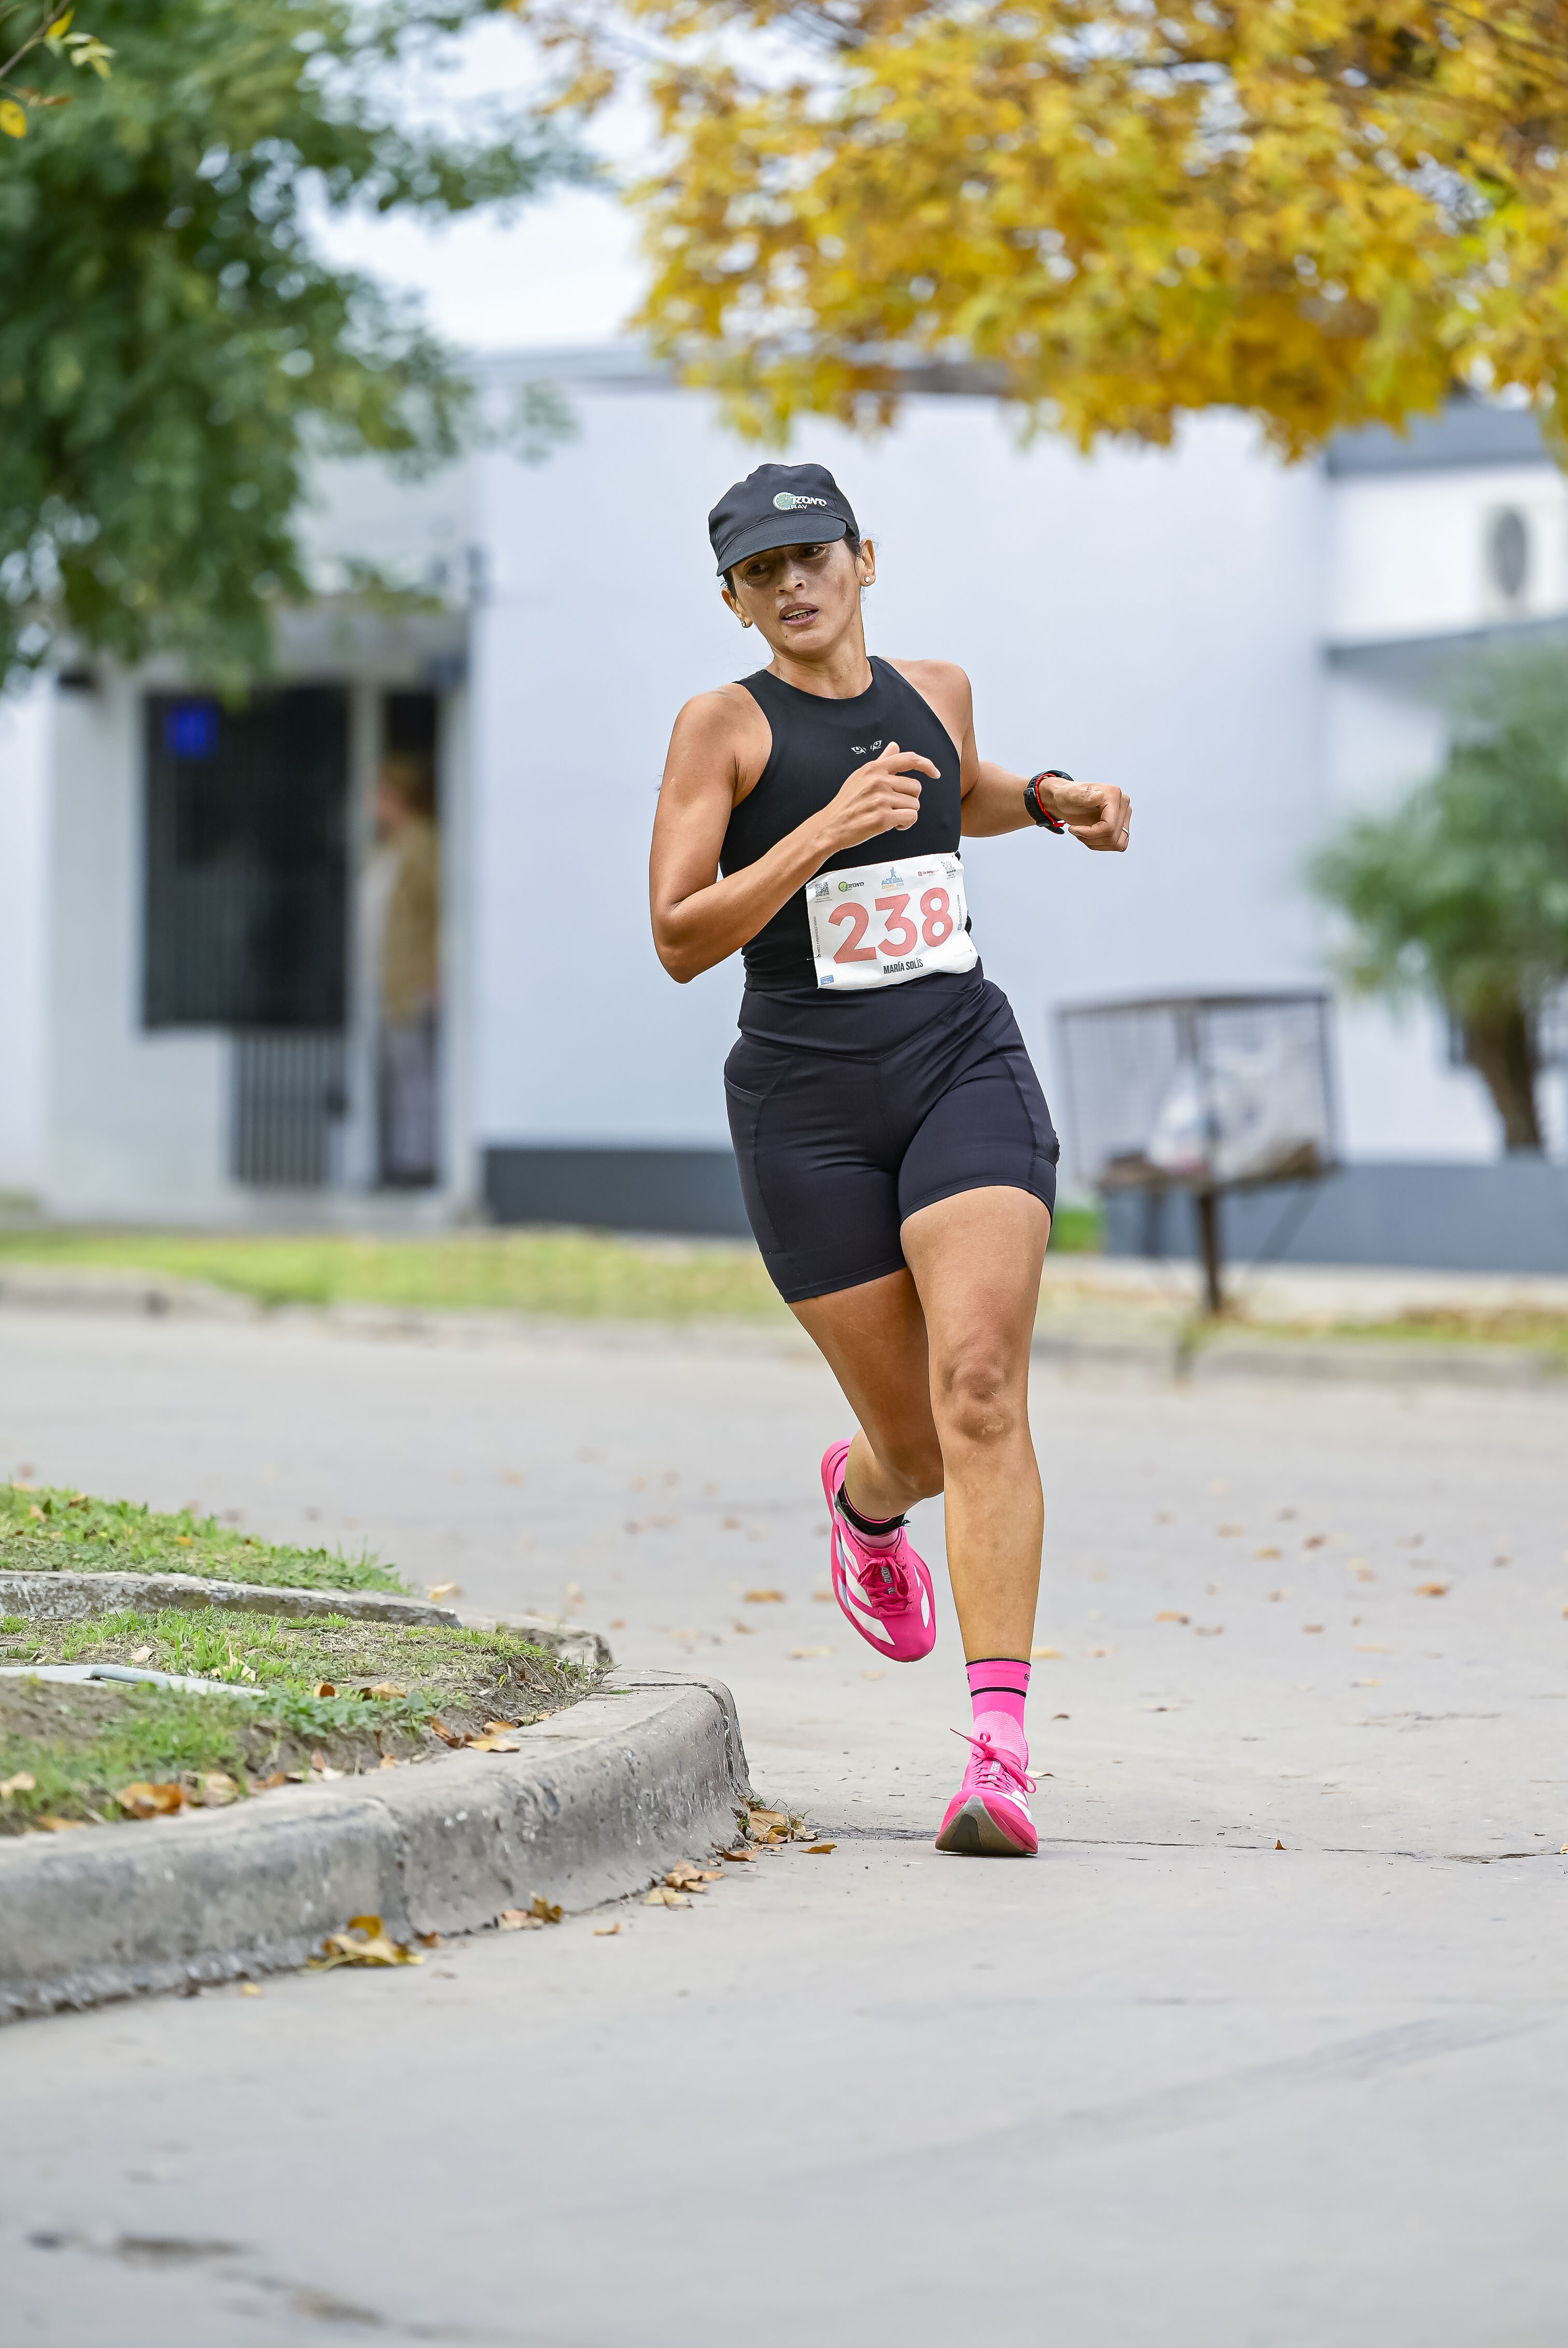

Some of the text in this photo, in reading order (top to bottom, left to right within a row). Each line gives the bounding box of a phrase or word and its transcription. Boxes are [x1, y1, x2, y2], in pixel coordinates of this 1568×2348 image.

[828, 887, 953, 964] 238
[883, 957, 923, 974] MARÍA SOLÍS
